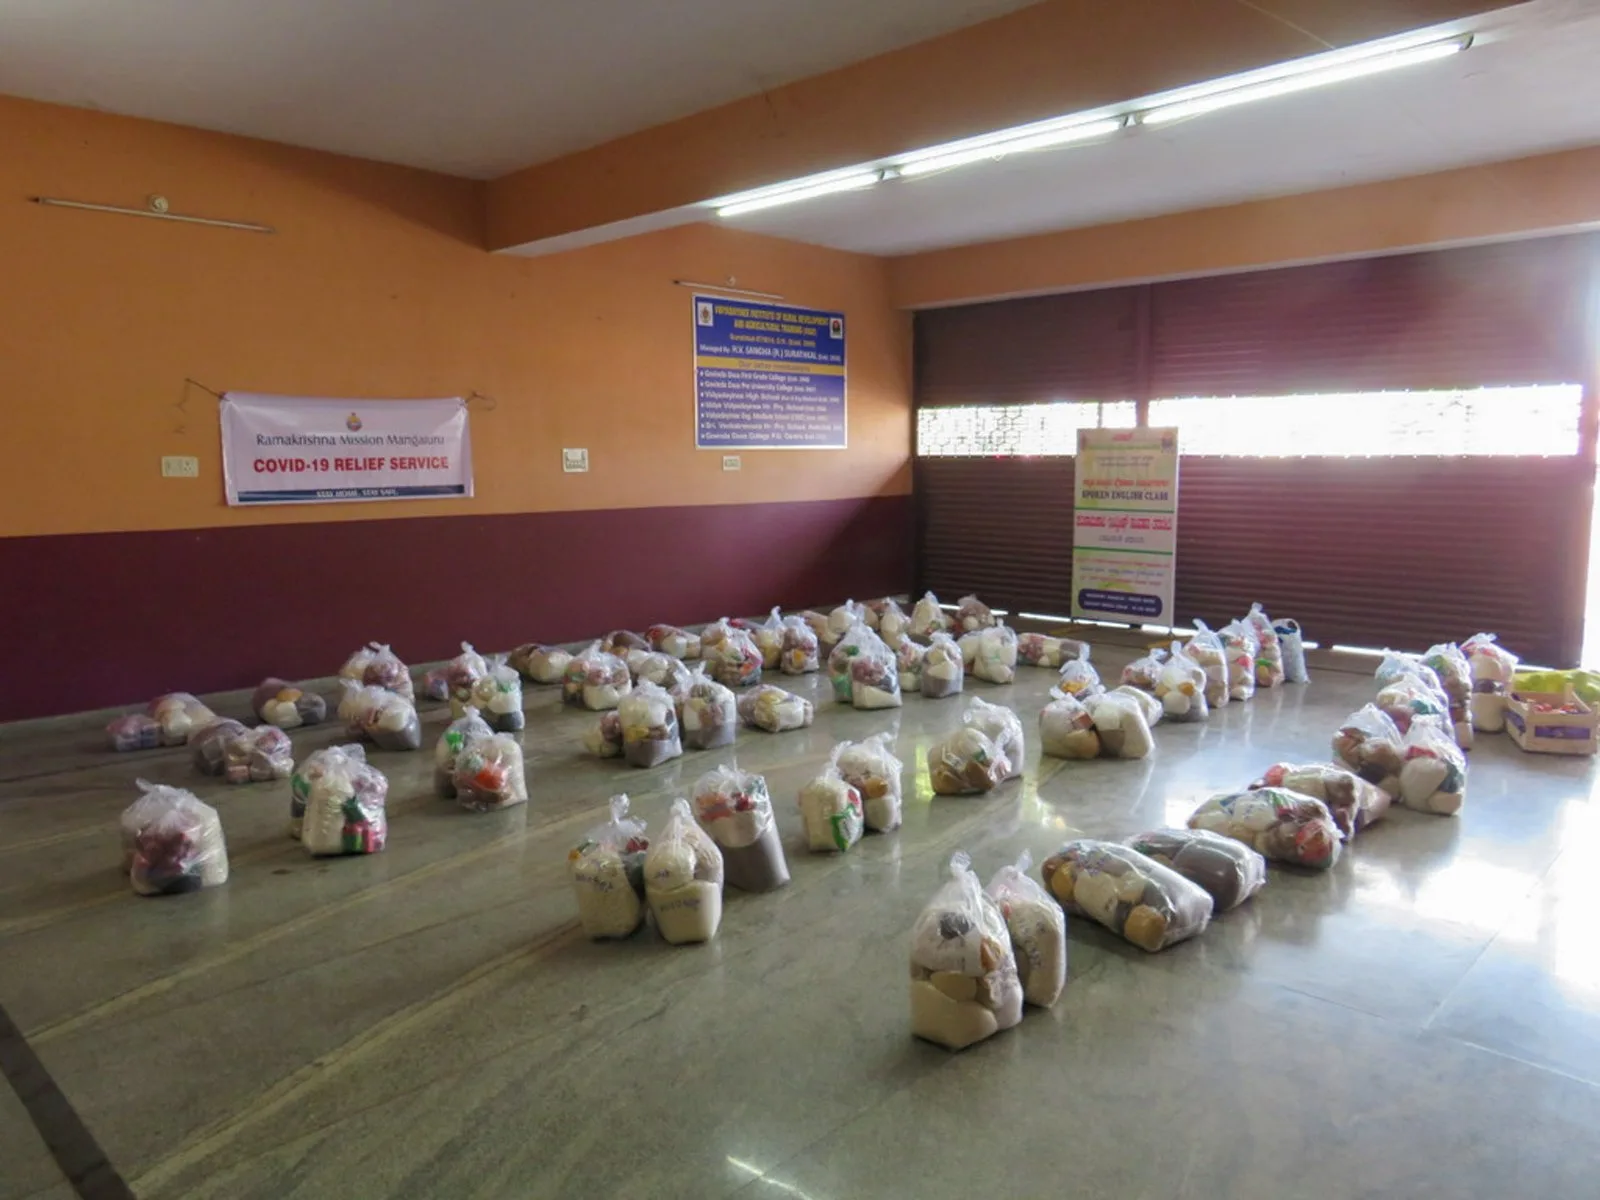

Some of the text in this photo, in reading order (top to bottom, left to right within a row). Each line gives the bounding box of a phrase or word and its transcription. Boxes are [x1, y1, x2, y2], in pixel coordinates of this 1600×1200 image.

[256, 434, 336, 445] Ramakrishna
[340, 434, 384, 445] Mission
[254, 456, 449, 473] COVID-19 RELIEF SERVICE
